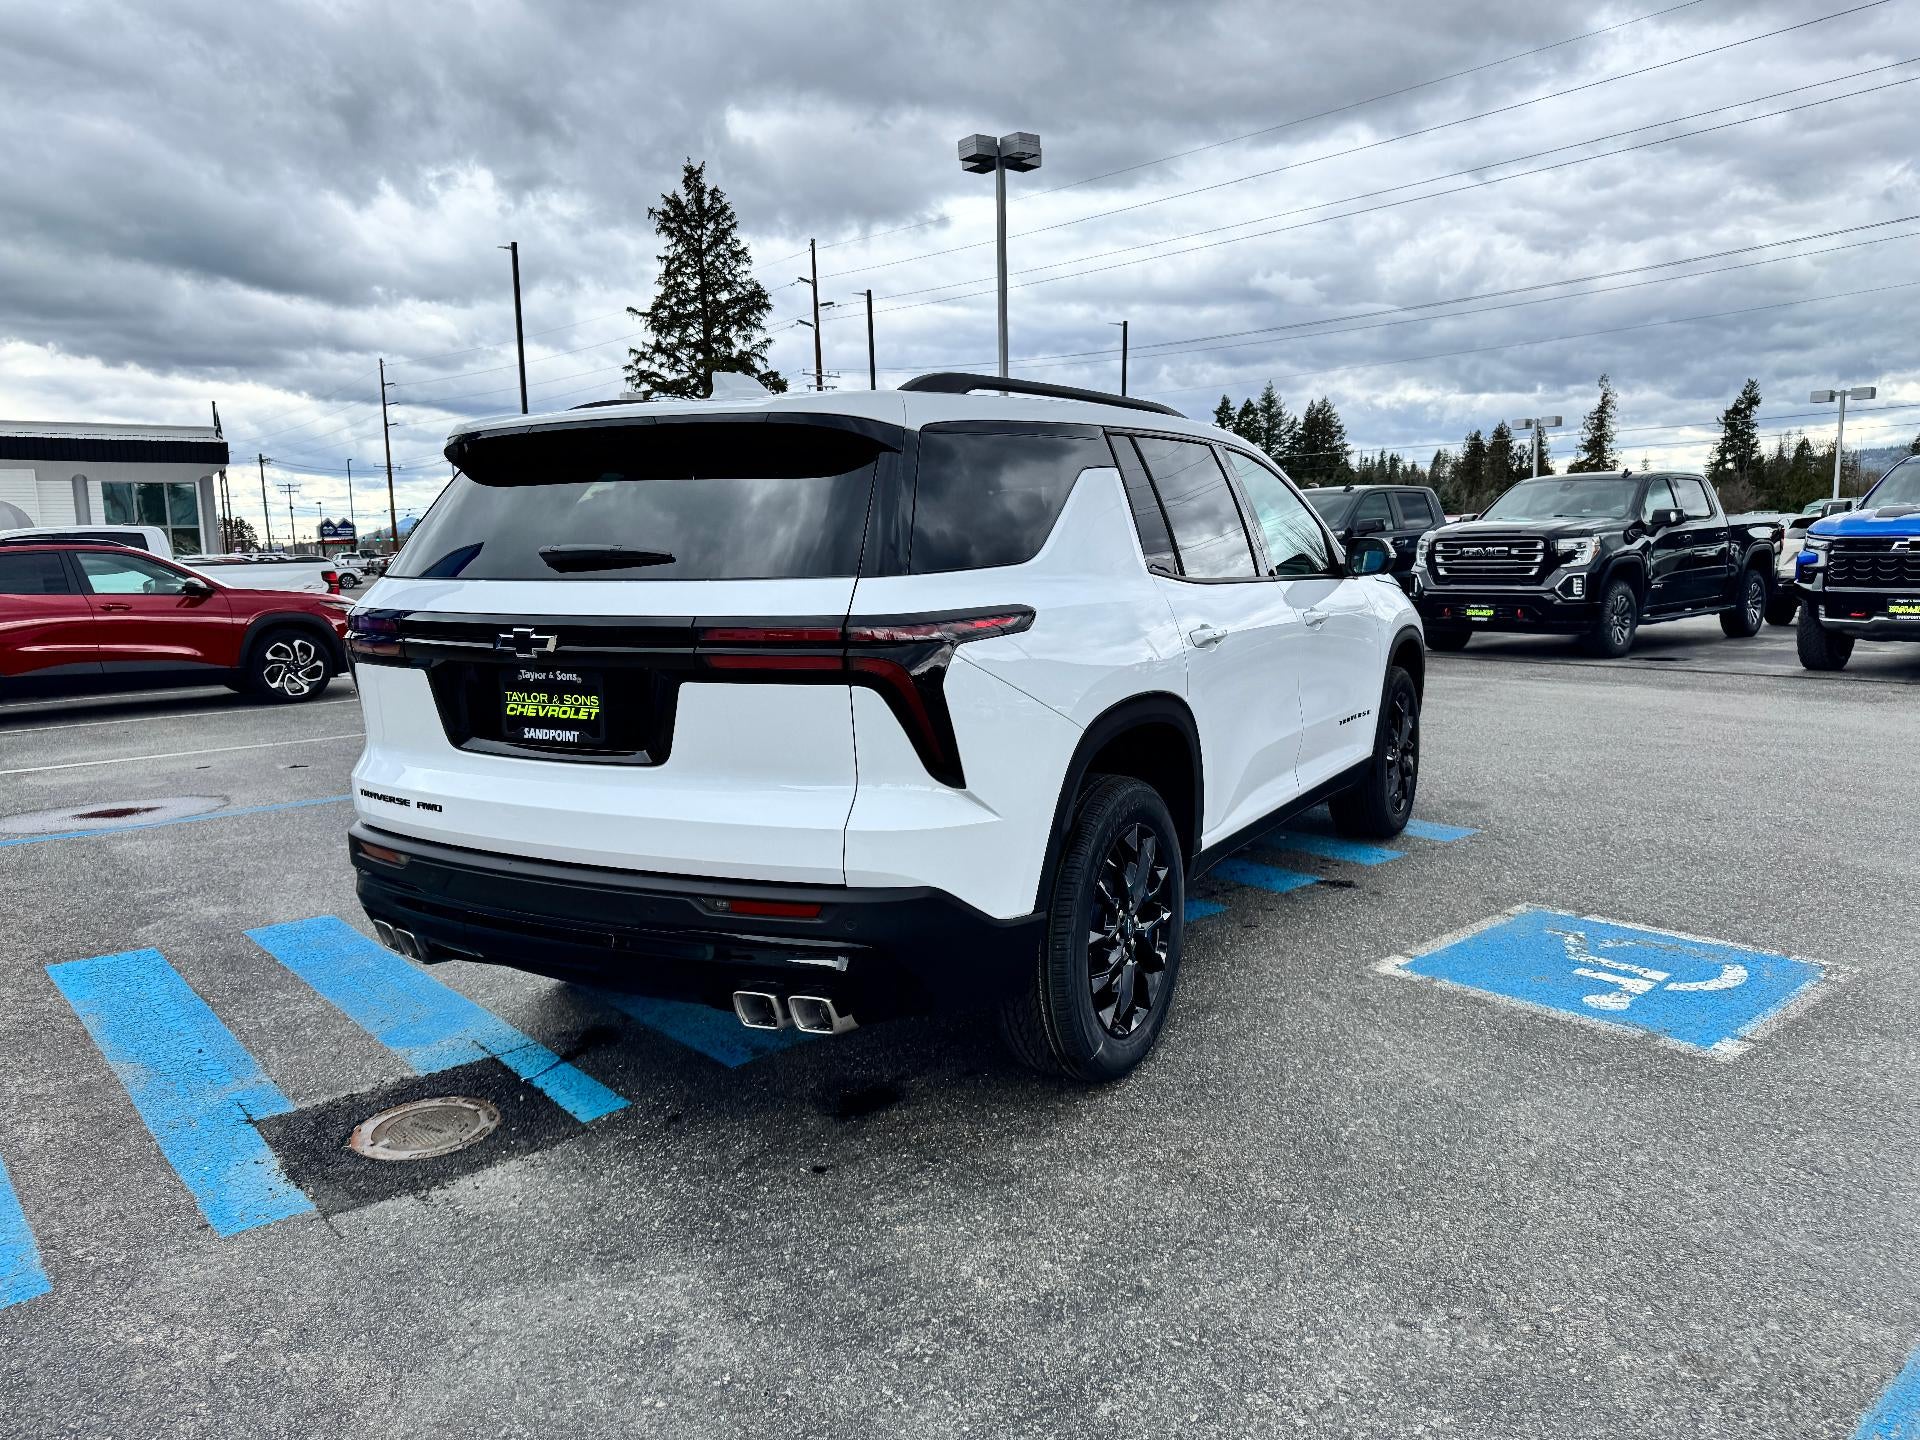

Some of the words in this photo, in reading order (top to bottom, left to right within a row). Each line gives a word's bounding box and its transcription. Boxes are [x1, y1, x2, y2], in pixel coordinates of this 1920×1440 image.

[1462, 547, 1508, 557] GMC
[520, 669, 547, 681] Taylor
[548, 671, 554, 679] &
[556, 670, 577, 681] Sons
[505, 691, 549, 703] TAYLOR
[552, 694, 560, 705] &
[563, 694, 599, 706] SONS
[506, 703, 600, 720] CHEVROLET
[523, 727, 580, 742] SANDPOINT
